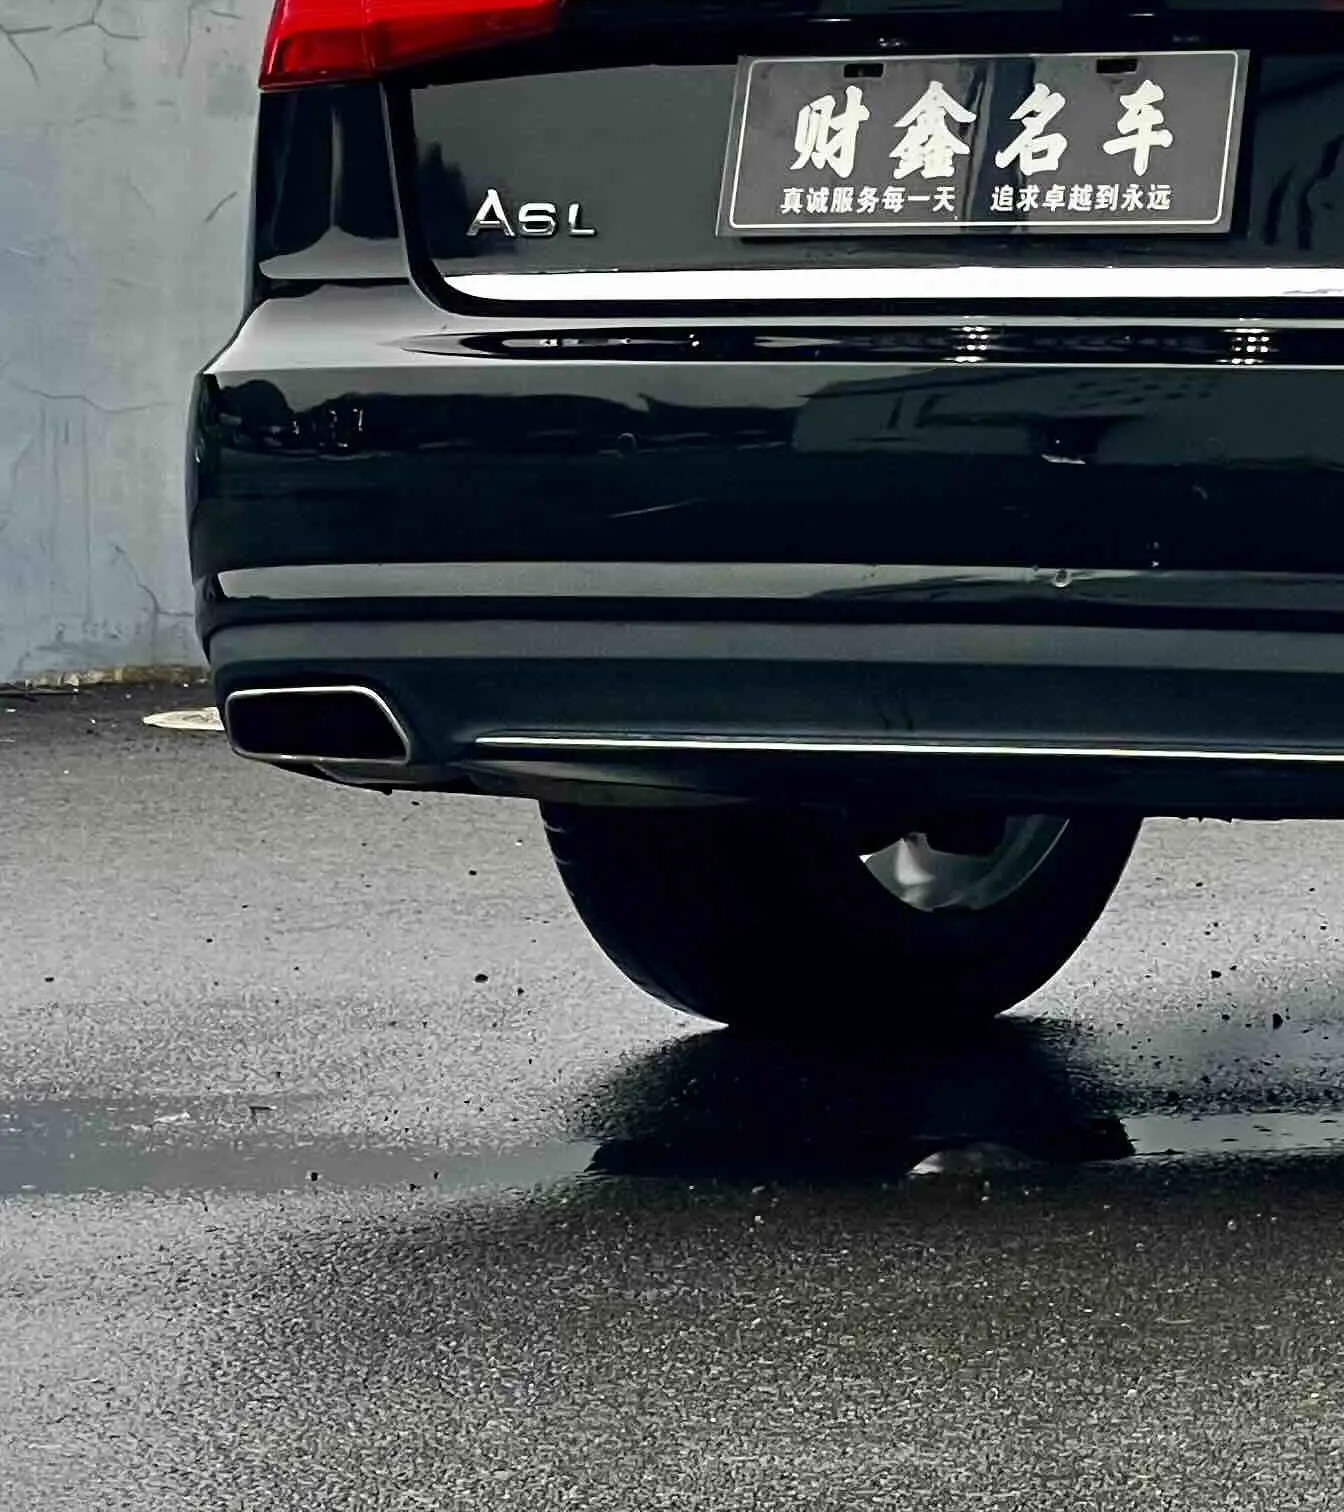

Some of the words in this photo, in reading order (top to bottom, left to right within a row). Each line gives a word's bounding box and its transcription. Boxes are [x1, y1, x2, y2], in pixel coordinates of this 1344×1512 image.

[789, 79, 1175, 179] 财鑫名车
[466, 188, 596, 238] A6L
[780, 185, 957, 214] 真诚服务每一天
[989, 182, 1174, 213] 追求卓越到永远
